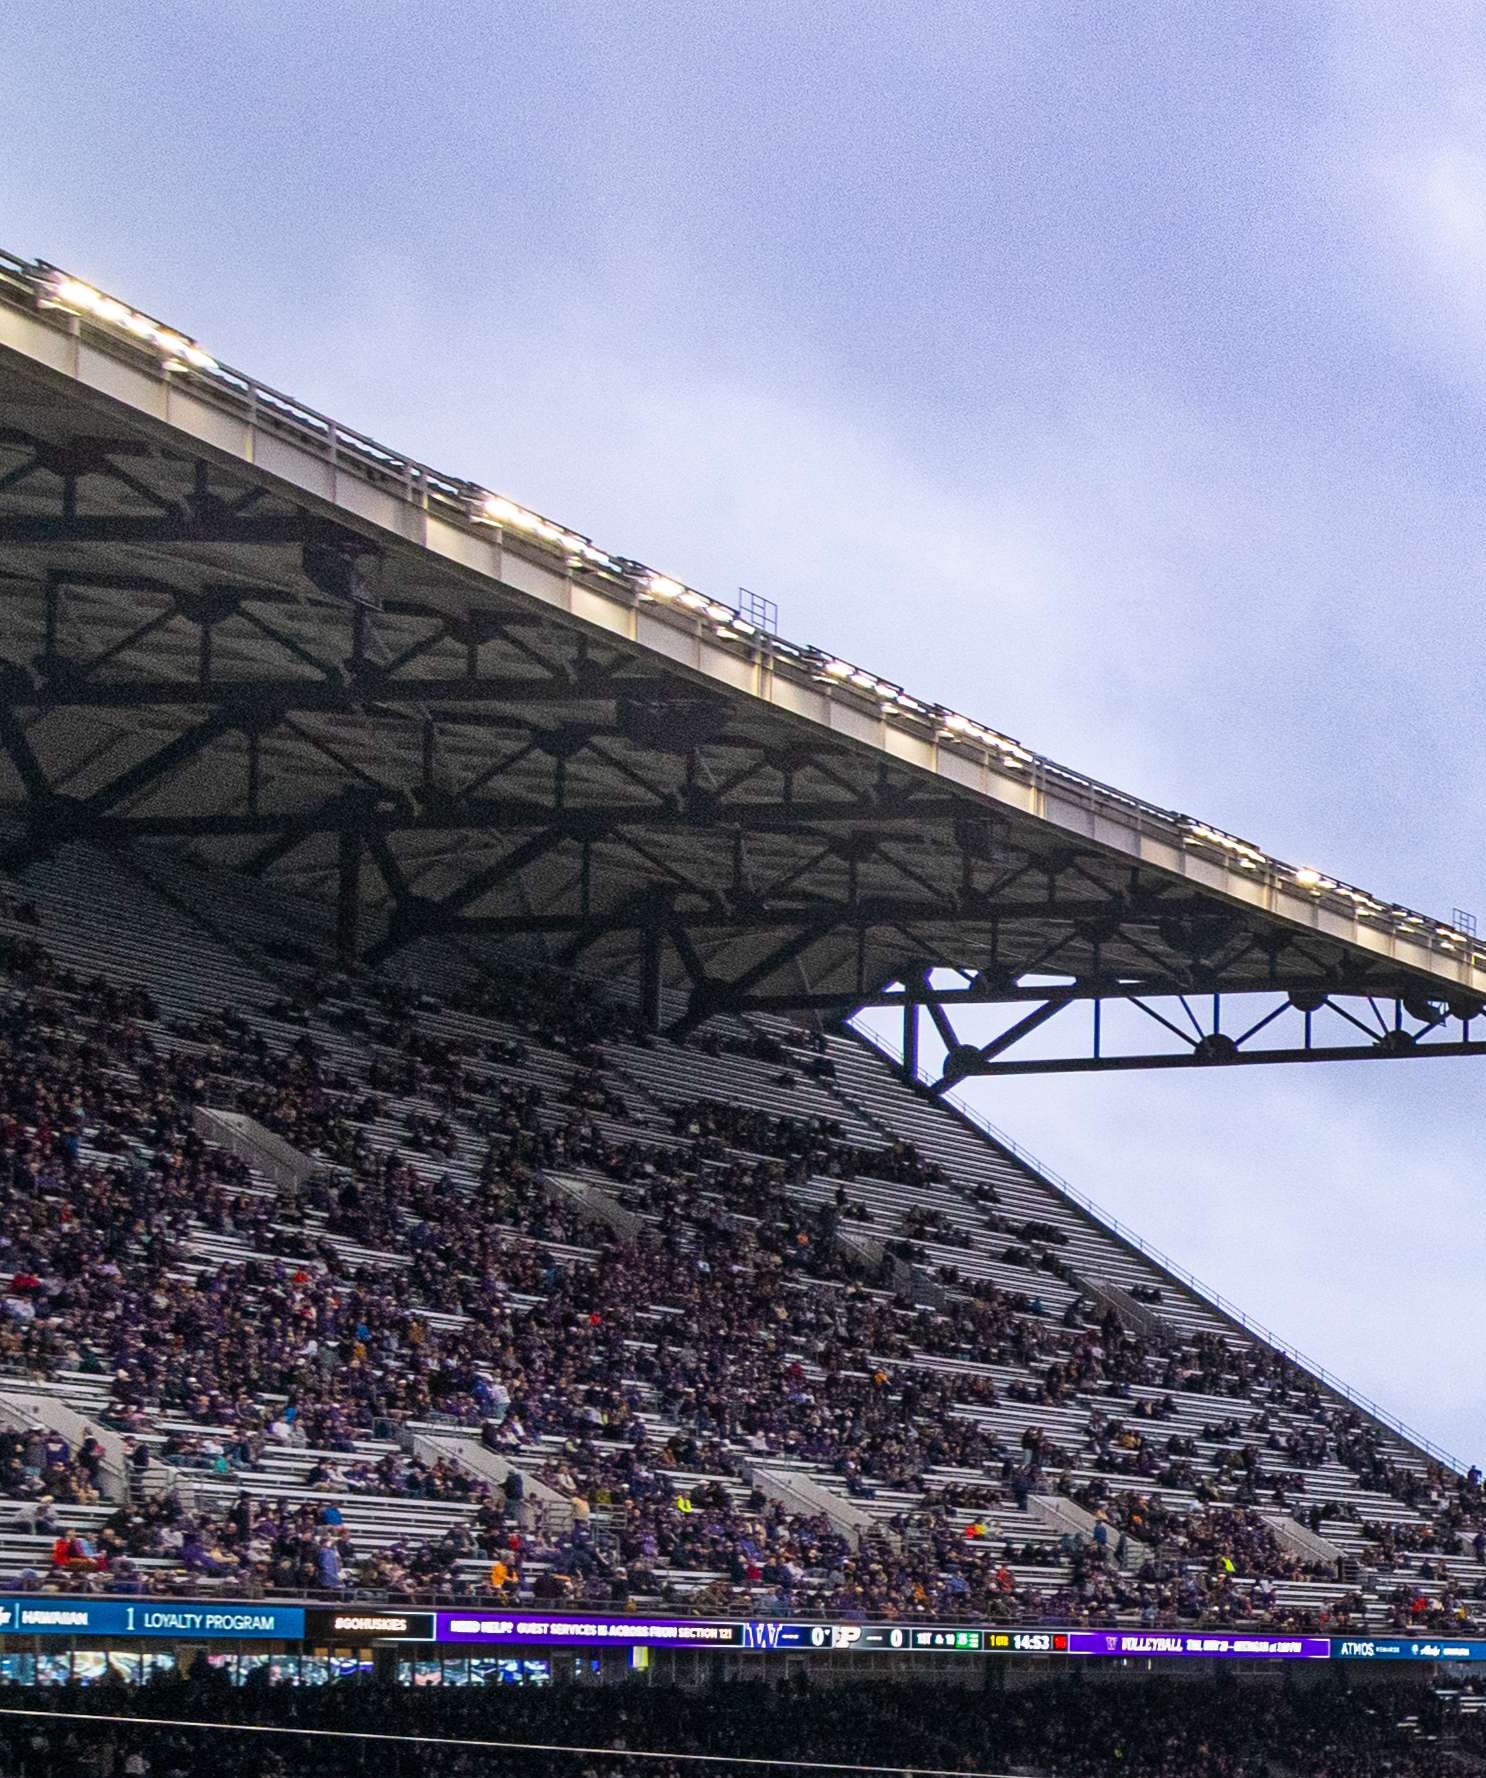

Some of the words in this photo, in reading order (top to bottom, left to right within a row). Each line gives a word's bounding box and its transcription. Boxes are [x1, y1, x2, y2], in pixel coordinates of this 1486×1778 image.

[144, 1612, 202, 1629] LOYALTY
[206, 1615, 275, 1631] PROGRAM
[678, 1628, 718, 1639] SECTION
[811, 1627, 825, 1646] 0
[889, 1629, 903, 1648] 0
[1014, 1634, 1050, 1650] 14:53
[1121, 1637, 1183, 1652] VOLLEYBALL
